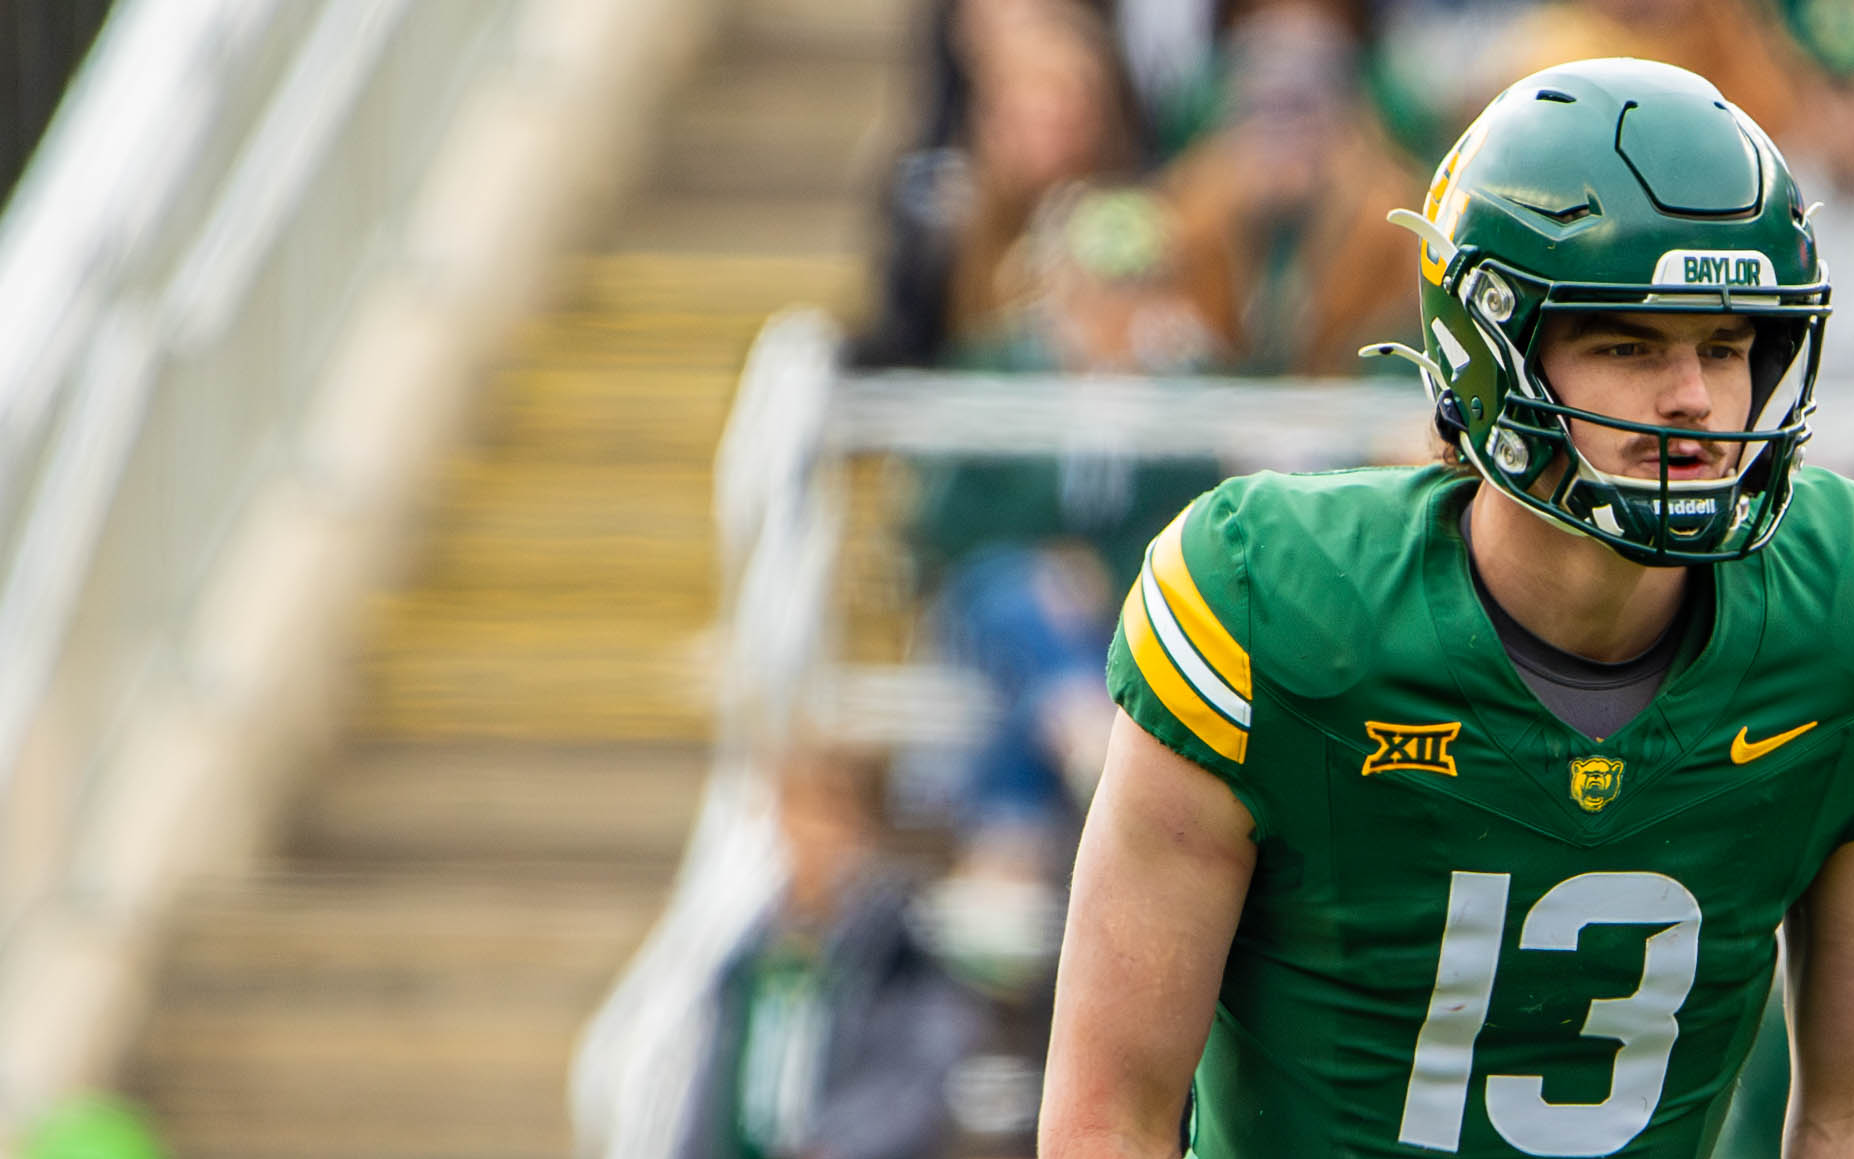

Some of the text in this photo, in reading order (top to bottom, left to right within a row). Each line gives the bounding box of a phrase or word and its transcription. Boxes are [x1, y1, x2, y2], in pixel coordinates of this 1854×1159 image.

[1684, 256, 1760, 286] BAYLOR
[1362, 721, 1461, 776] XII
[1398, 870, 1703, 1159] 13
